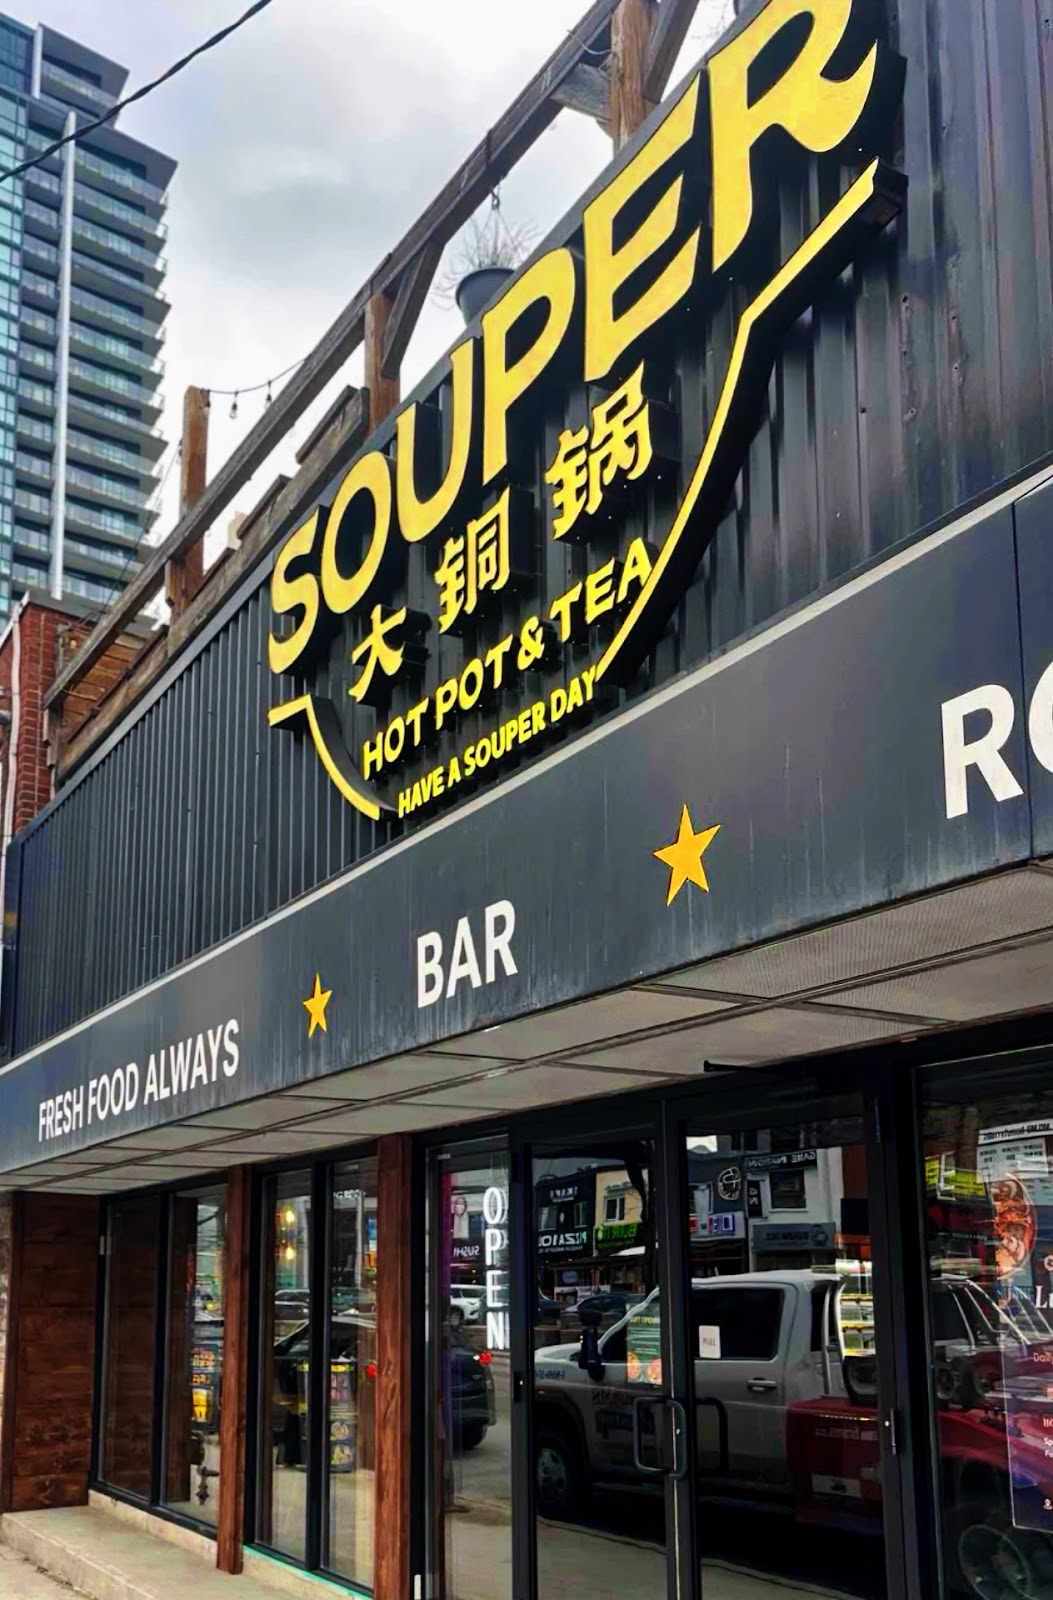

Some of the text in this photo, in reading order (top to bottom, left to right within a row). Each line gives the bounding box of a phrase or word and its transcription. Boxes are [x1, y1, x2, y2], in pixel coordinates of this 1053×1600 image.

[268, 0, 877, 674] SOUPER
[363, 537, 653, 780] HOT POT & TEA
[398, 664, 597, 818] HAVE A SOUPER DAY
[417, 899, 518, 1009] BAR
[38, 1018, 240, 1142] FRESH FOOD ALWAYS
[483, 1187, 505, 1350] OPEN
